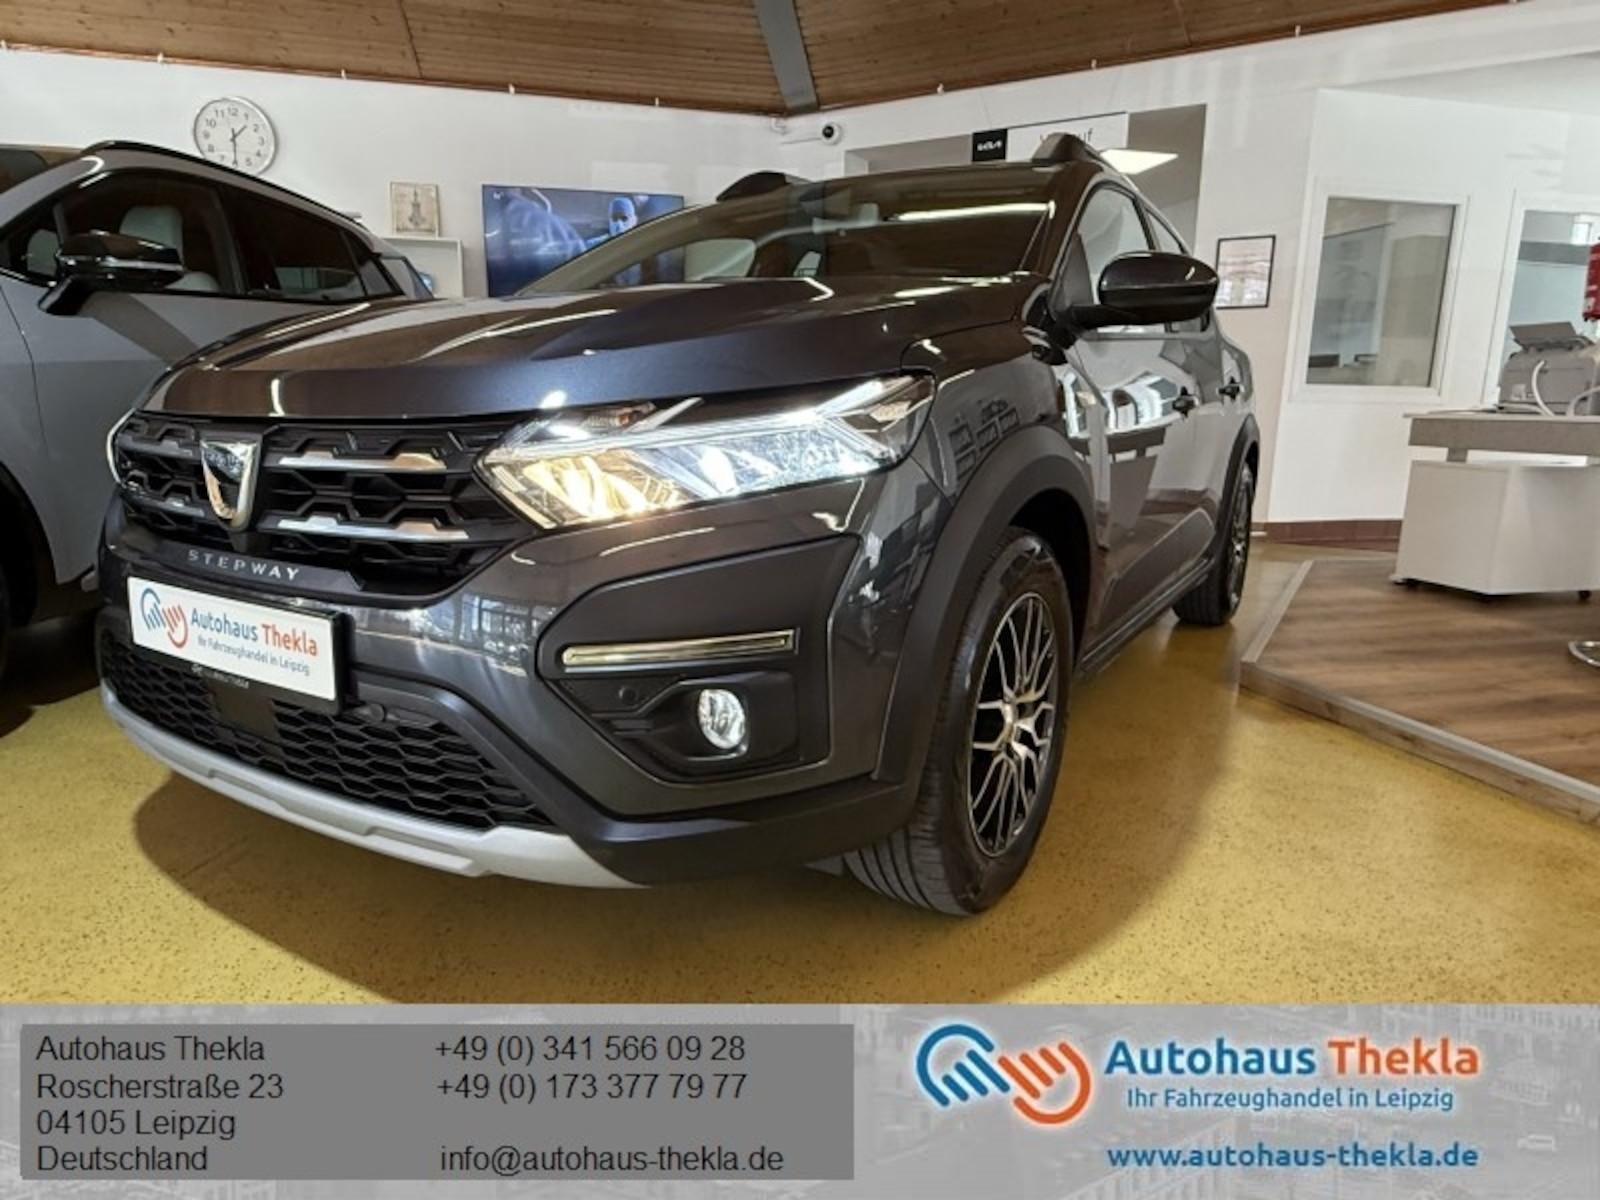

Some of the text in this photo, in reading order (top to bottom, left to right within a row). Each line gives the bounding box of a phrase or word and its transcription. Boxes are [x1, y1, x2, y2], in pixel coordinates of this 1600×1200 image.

[215, 109, 225, 118] 11
[227, 107, 239, 117] 12
[205, 118, 217, 128] 10
[188, 550, 300, 581] STEPWAY
[191, 607, 319, 657] Autohaus Thekla
[279, 655, 311, 677] Leipzig
